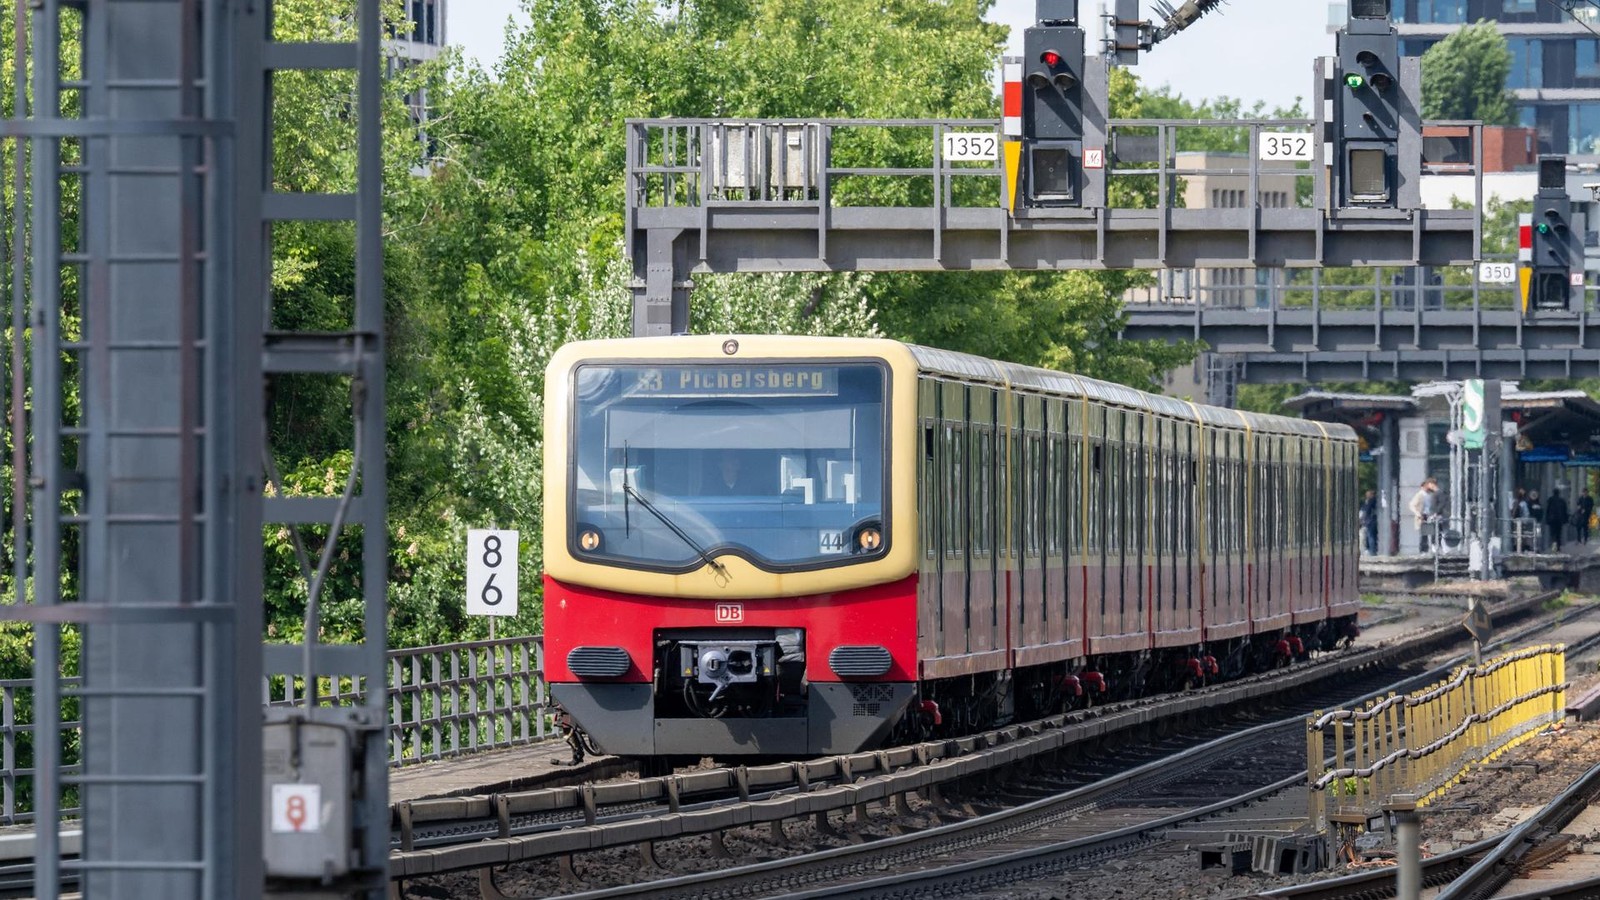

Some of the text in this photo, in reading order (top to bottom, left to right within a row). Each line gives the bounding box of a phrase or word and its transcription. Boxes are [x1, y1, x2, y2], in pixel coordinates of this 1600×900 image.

[947, 137, 995, 156] 1352
[1267, 137, 1307, 156] 352
[1485, 266, 1511, 279] 350
[679, 369, 823, 390] Pichelsberg
[821, 532, 843, 551] 44
[482, 535, 502, 568] 8
[481, 573, 503, 606] 6
[719, 606, 741, 620] DB
